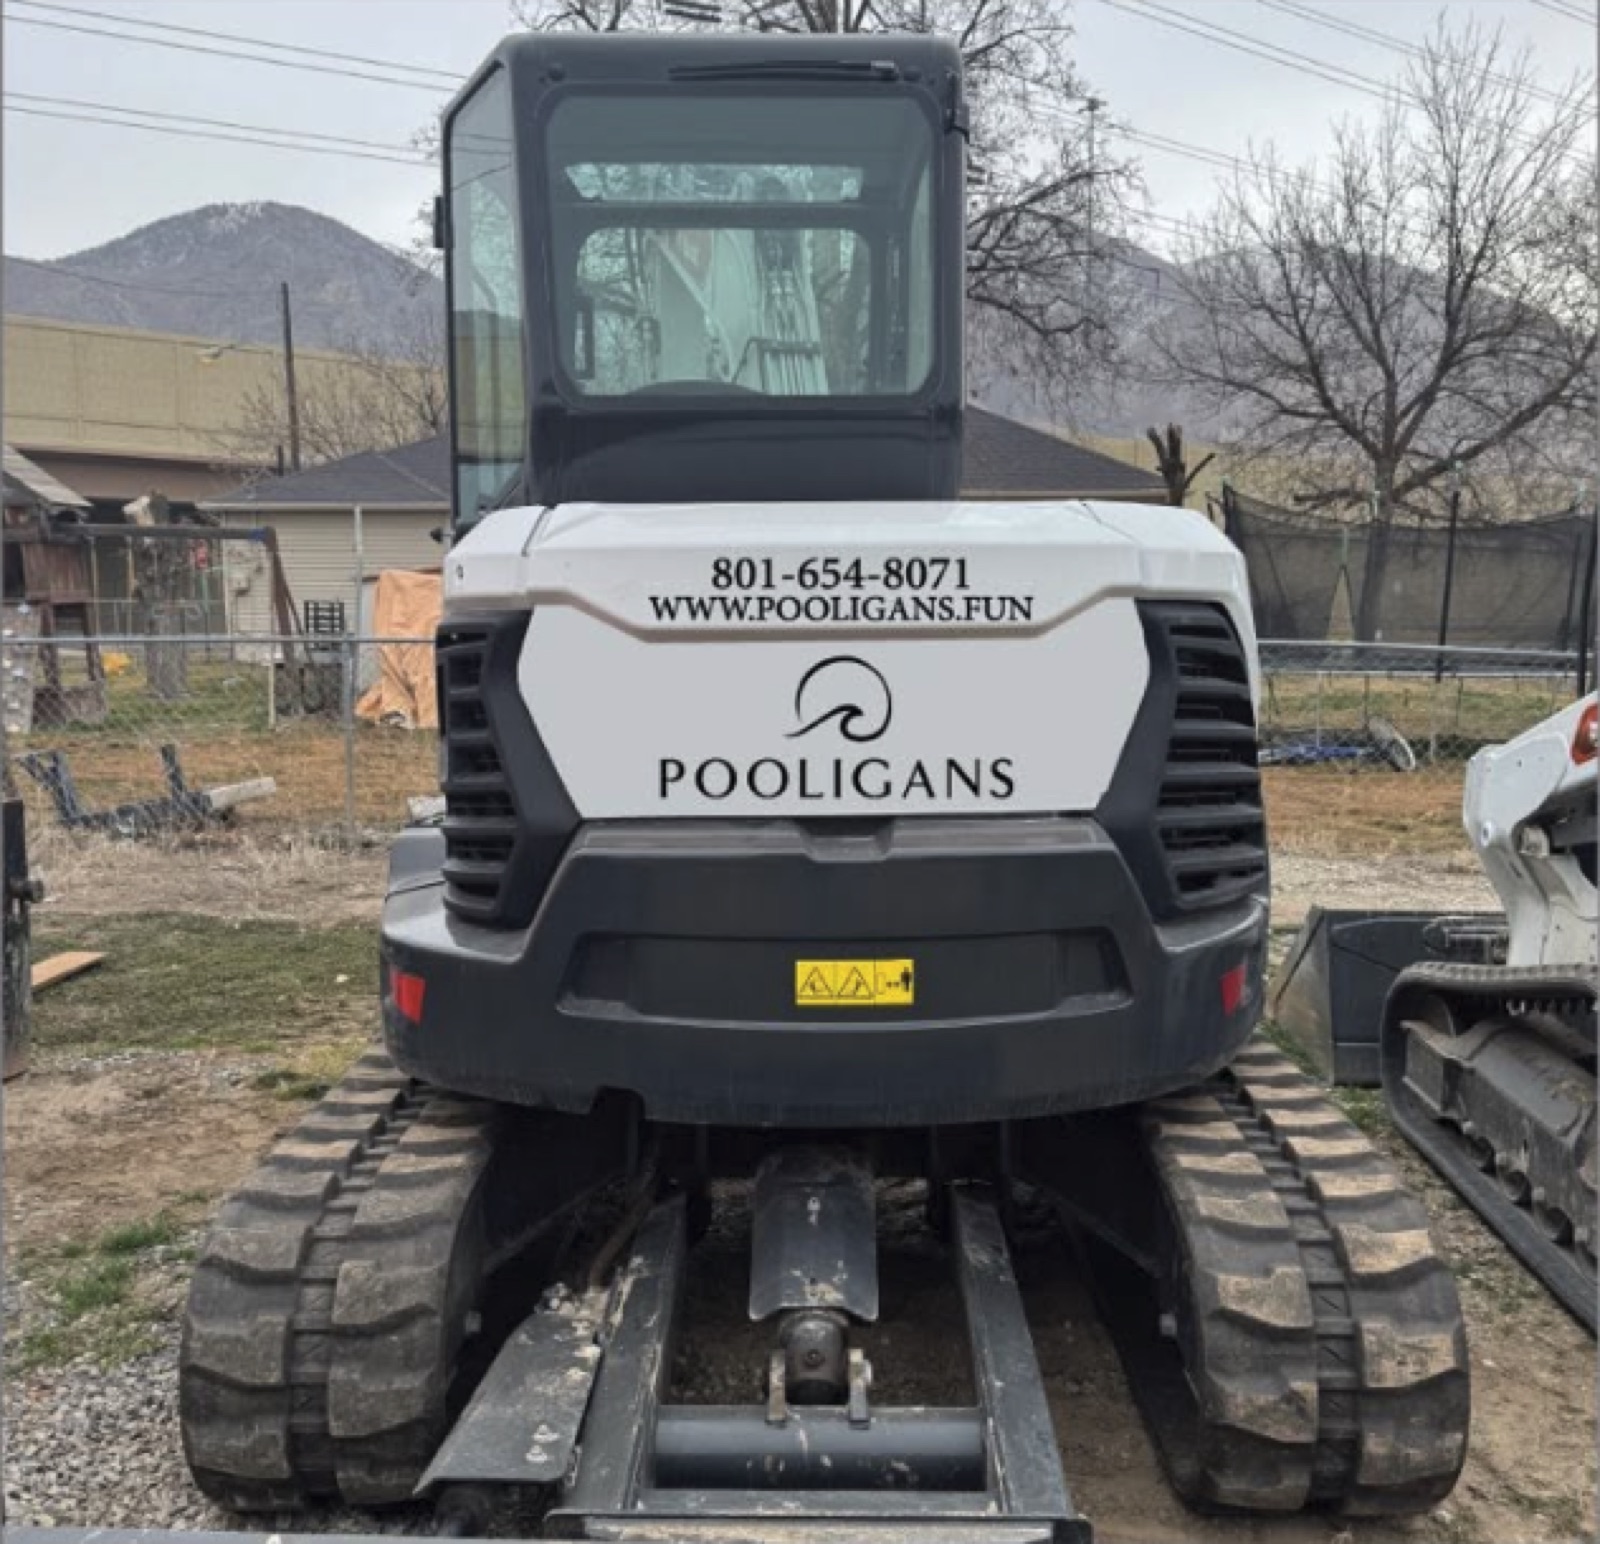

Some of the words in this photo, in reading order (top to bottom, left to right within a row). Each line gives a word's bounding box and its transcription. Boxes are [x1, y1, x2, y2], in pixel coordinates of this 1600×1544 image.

[711, 557, 970, 591] 801-654-8071
[649, 595, 1034, 623] WWW.POOLIGANS.FUN
[659, 757, 1015, 801] POOLIGANS
